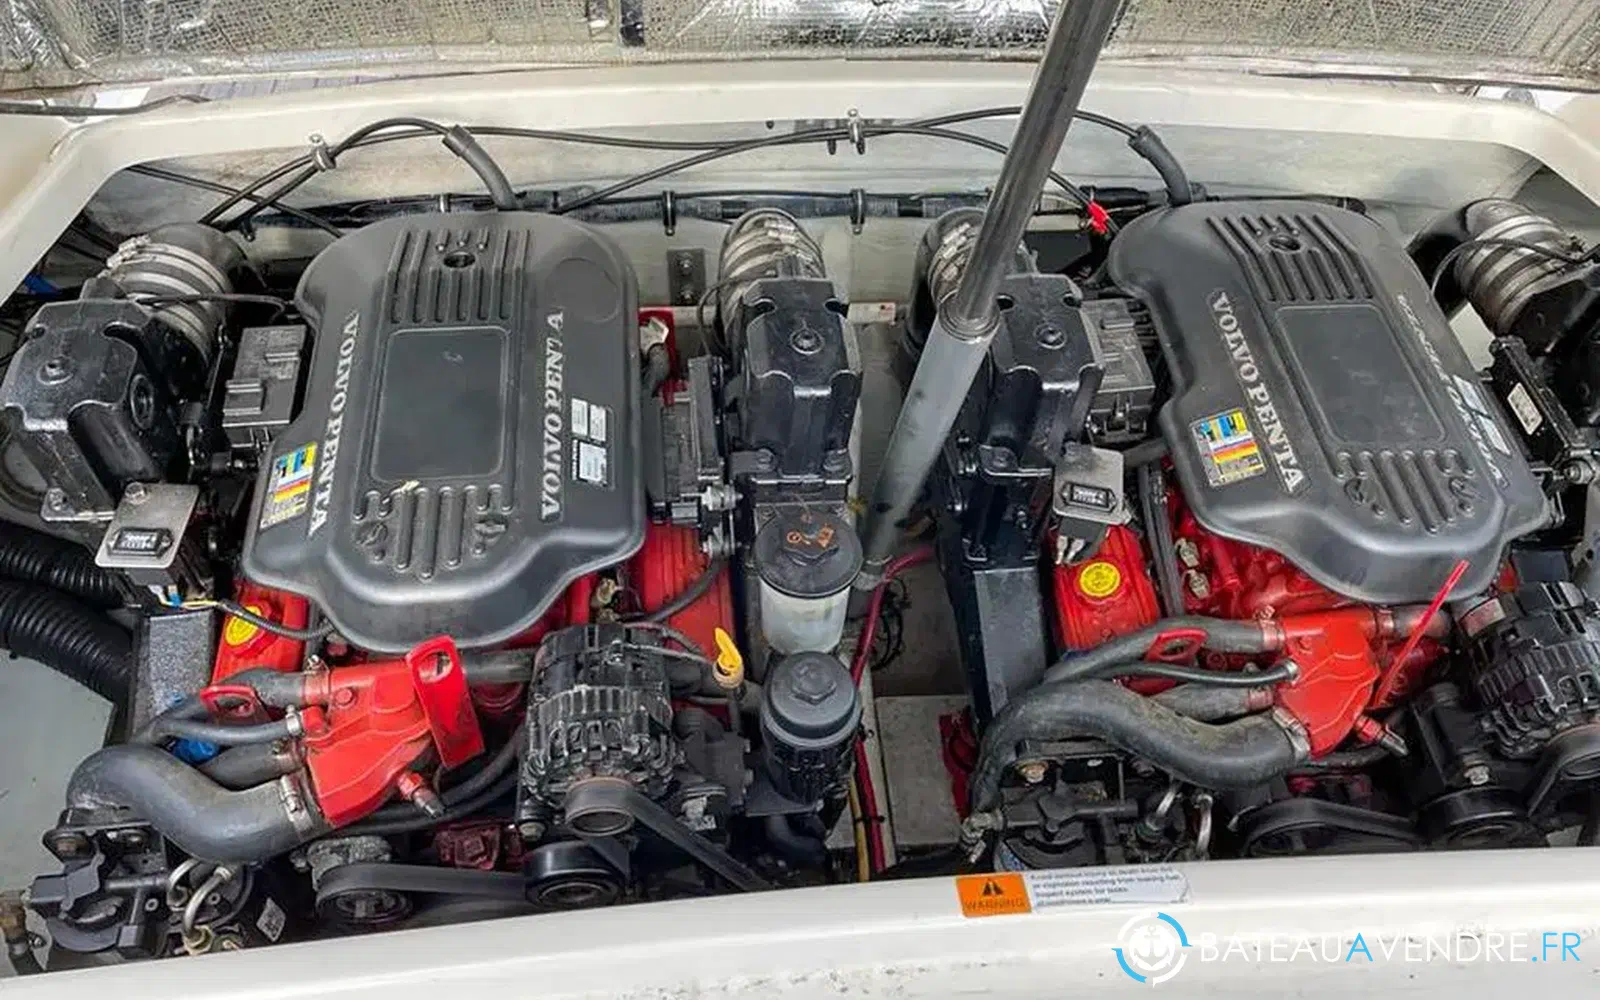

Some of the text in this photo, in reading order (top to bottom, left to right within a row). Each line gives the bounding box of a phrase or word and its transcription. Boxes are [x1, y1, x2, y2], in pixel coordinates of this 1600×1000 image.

[308, 311, 360, 537] VOLVO PENTA
[541, 311, 564, 519] VOLVO PENTA
[1212, 292, 1260, 382] VOLVO
[1247, 383, 1305, 493] PENTA
